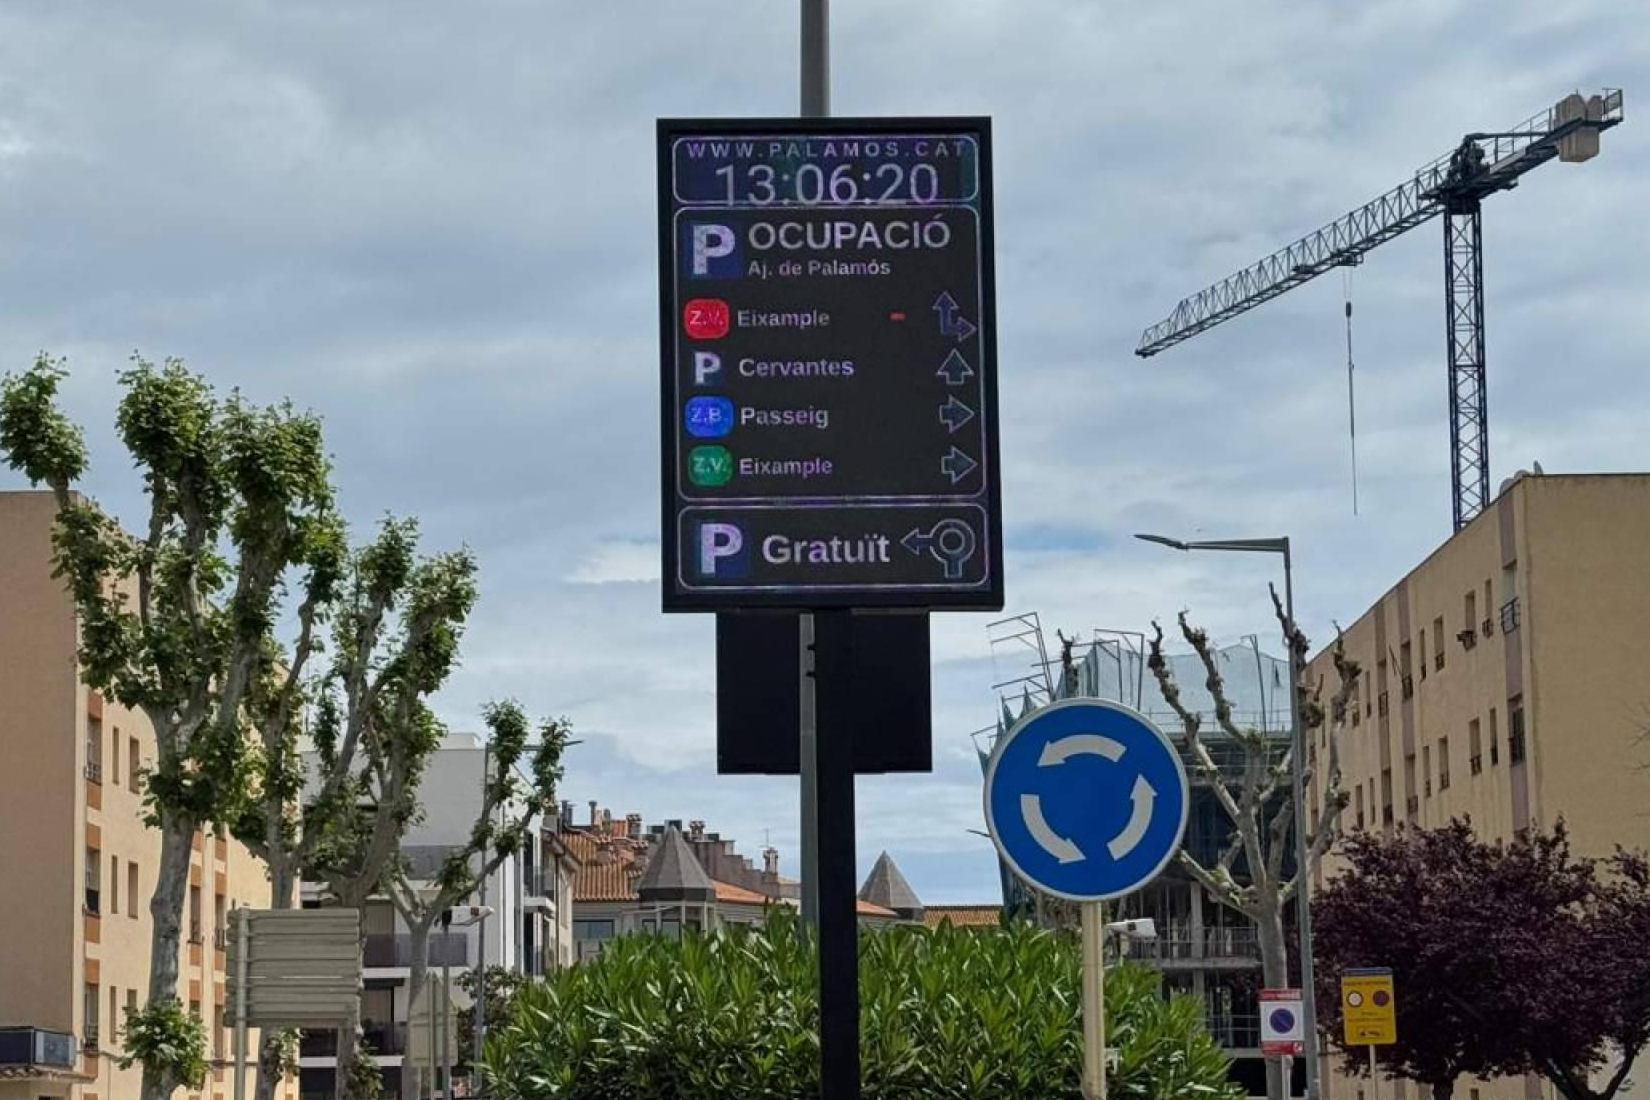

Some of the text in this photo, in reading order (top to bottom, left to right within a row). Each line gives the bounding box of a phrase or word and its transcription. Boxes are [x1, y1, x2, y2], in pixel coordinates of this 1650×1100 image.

[686, 141, 966, 158] WWW.PALAMOS.CAT
[715, 163, 939, 206] 13:06:20
[748, 213, 951, 250] OCUPACIÓ
[692, 224, 736, 275] P
[748, 259, 891, 279] Aj. de Palamós
[737, 309, 831, 328] Eixample
[694, 351, 855, 386] P Cervantes
[740, 405, 830, 429] Passeig
[738, 457, 834, 479] Eixample
[700, 523, 891, 575] P Gratuït
